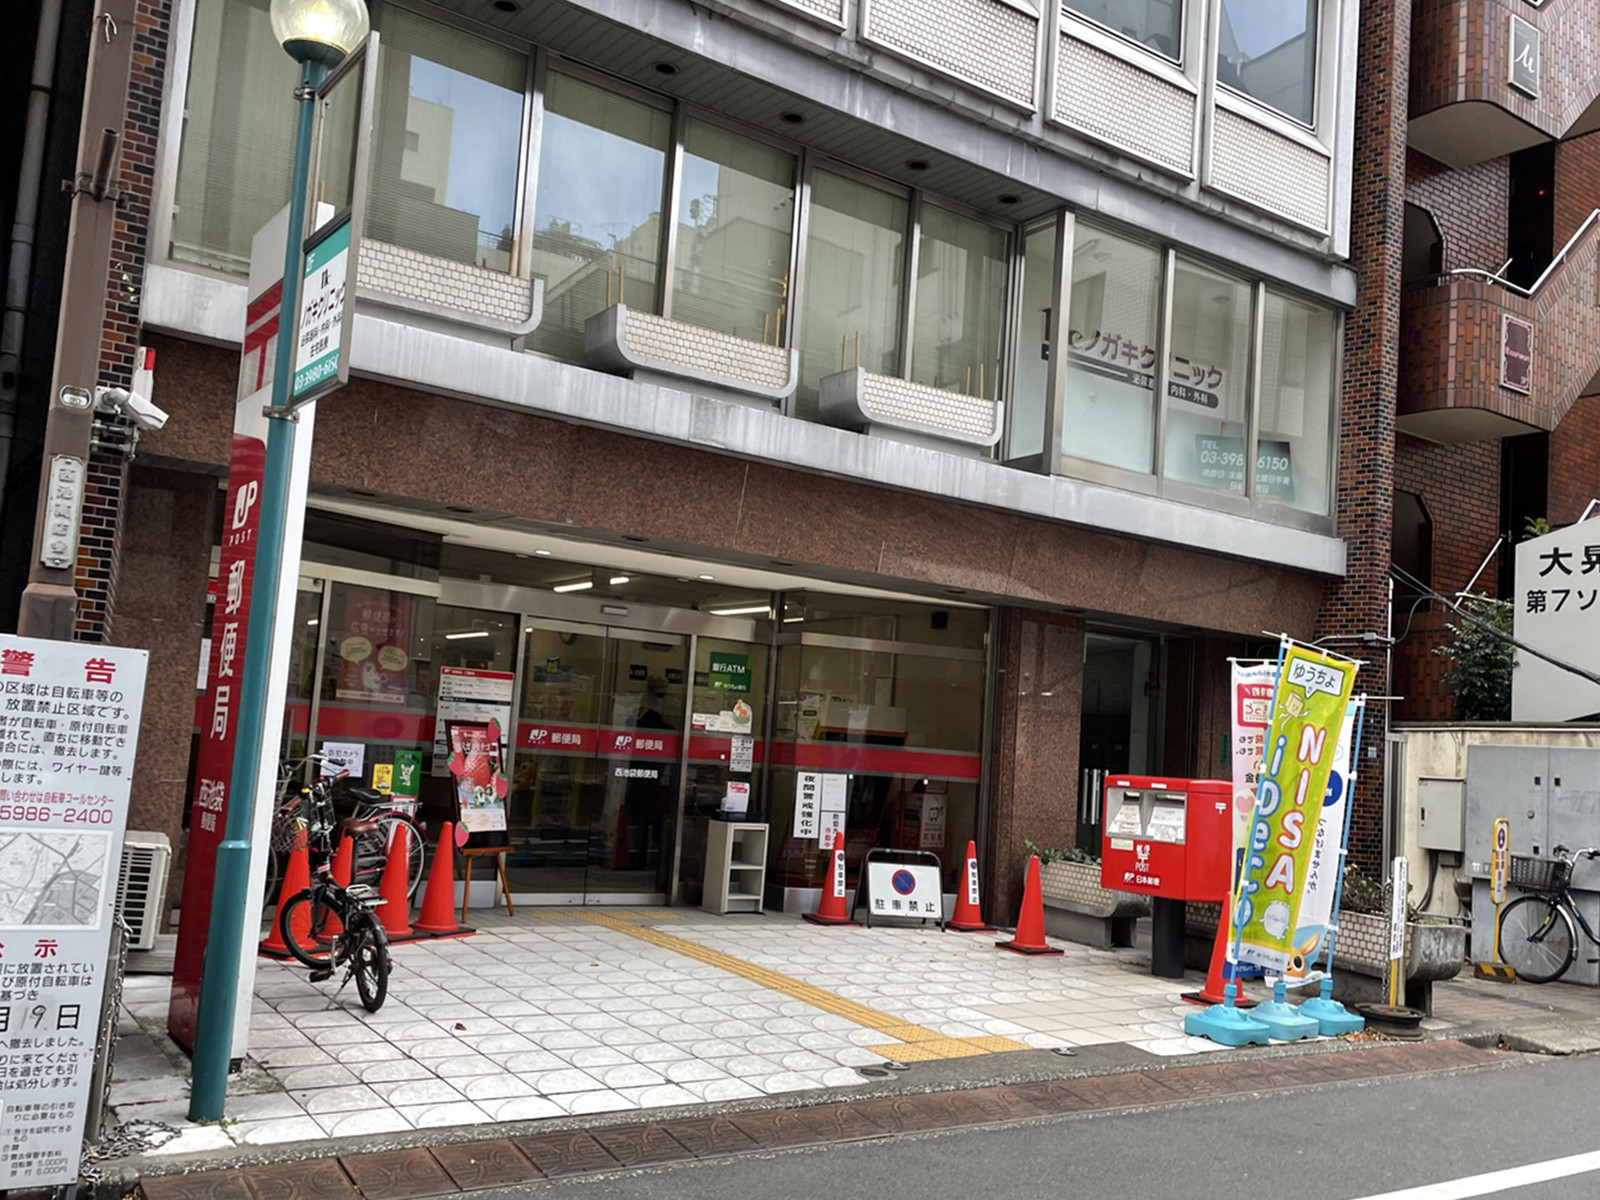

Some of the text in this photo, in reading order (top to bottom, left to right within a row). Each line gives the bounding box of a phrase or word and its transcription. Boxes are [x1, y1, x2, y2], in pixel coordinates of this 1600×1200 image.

[1201, 440, 1219, 450] TEL
[229, 529, 252, 547] POST
[209, 558, 246, 742] 郵便局
[1, 648, 117, 684] 警告
[712, 662, 746, 674] 銀行ATM
[1293, 662, 1336, 689] ゆうちょ
[5, 698, 130, 720] 放置禁止区域です。
[551, 732, 582, 746] 郵便局
[635, 739, 664, 751] 郵便局
[0, 741, 119, 760] 合には、撤去します。
[0, 758, 123, 777] 際には、ワイヤー鍵等
[615, 767, 658, 779] 西池袋郵便局
[1264, 723, 1327, 896] NISA
[875, 898, 936, 913] 駐車禁止
[0, 962, 95, 975] に放置されてい
[0, 1077, 78, 1090] は処分します。
